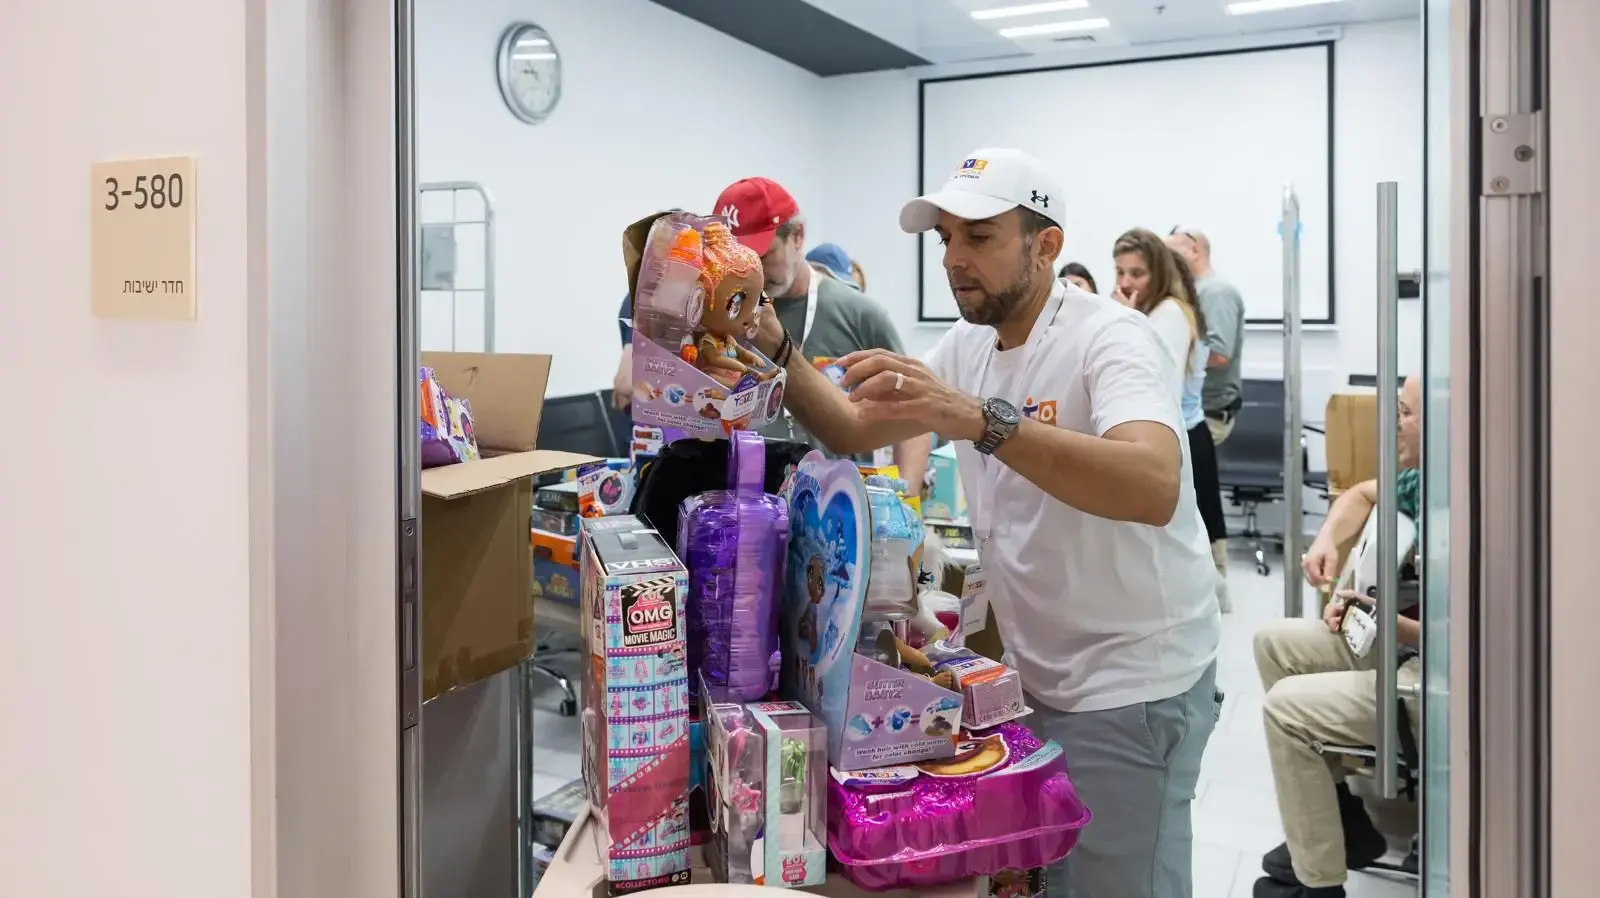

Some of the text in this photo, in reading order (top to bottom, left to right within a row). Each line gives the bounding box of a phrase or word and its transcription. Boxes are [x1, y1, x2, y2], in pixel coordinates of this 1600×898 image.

[105, 173, 183, 210] 3-580
[122, 280, 184, 294] חדר ישיבות
[631, 605, 672, 624] OMG
[625, 628, 675, 645] MOVIE MAGIC
